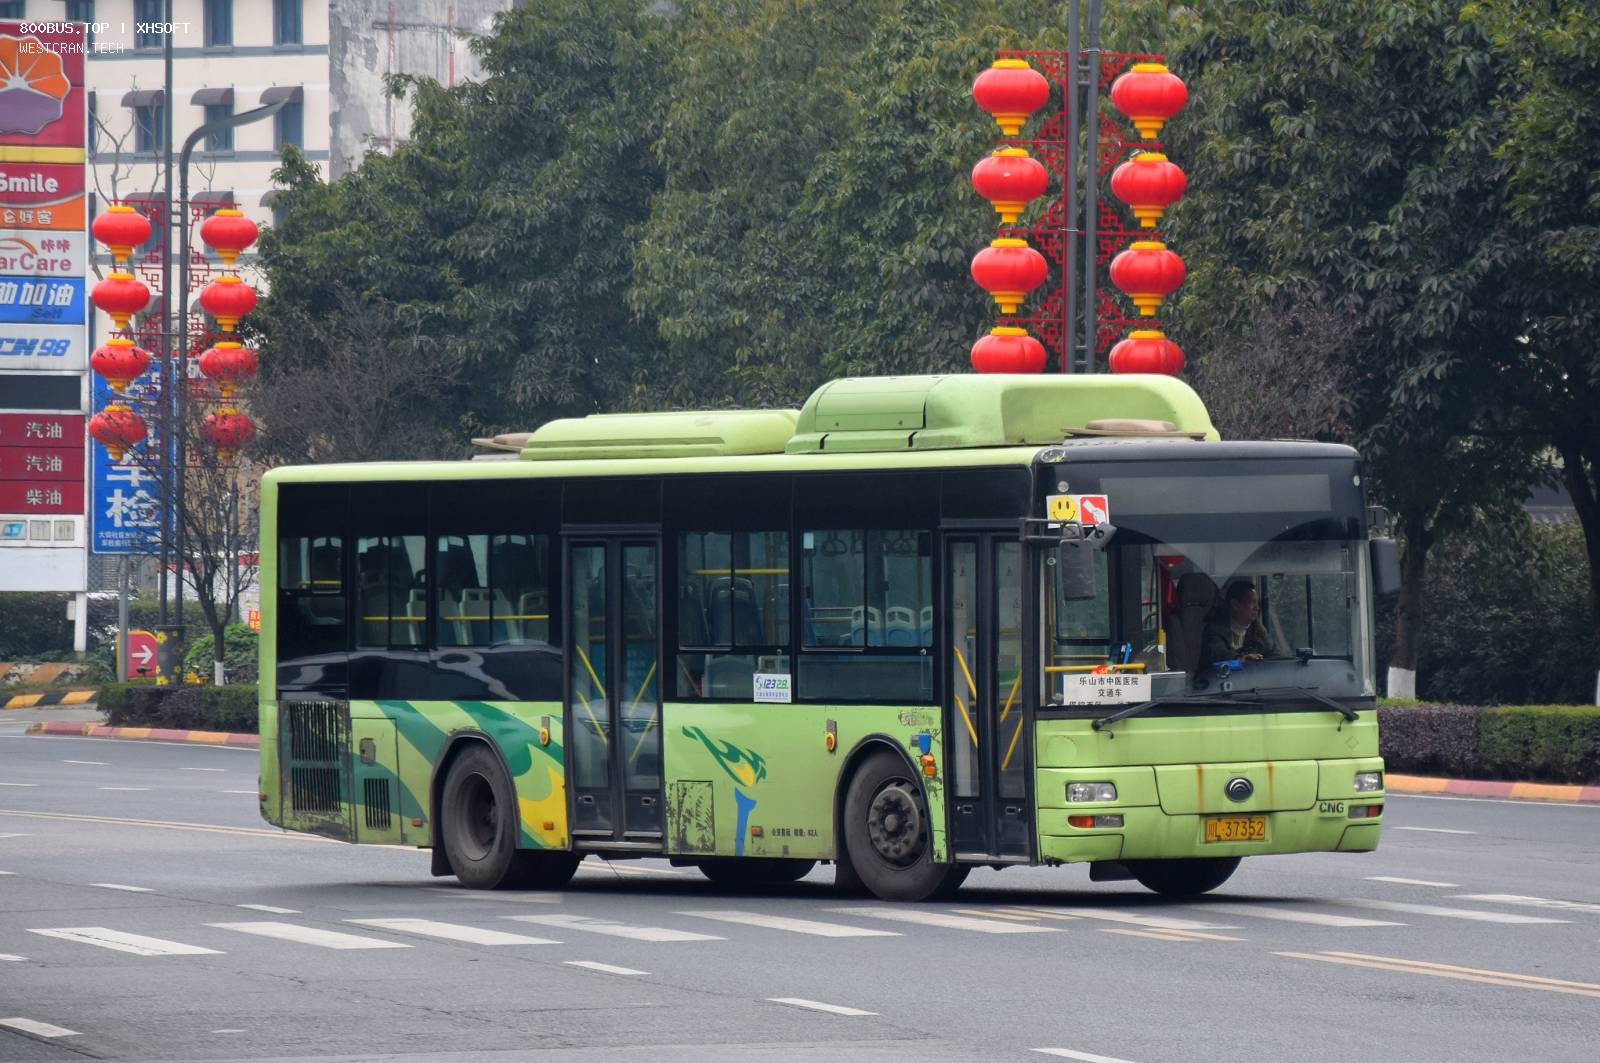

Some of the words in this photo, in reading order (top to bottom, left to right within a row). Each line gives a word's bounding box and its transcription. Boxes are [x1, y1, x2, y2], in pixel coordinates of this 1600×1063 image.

[40, 239, 70, 253] 咔咔
[26, 421, 62, 438] 汽油
[26, 455, 62, 472] 汽油
[26, 488, 62, 506] 柴油
[1079, 676, 1139, 686] 乐山市中医医院
[1098, 688, 1122, 697] 交通车
[1320, 802, 1345, 813] CNG
